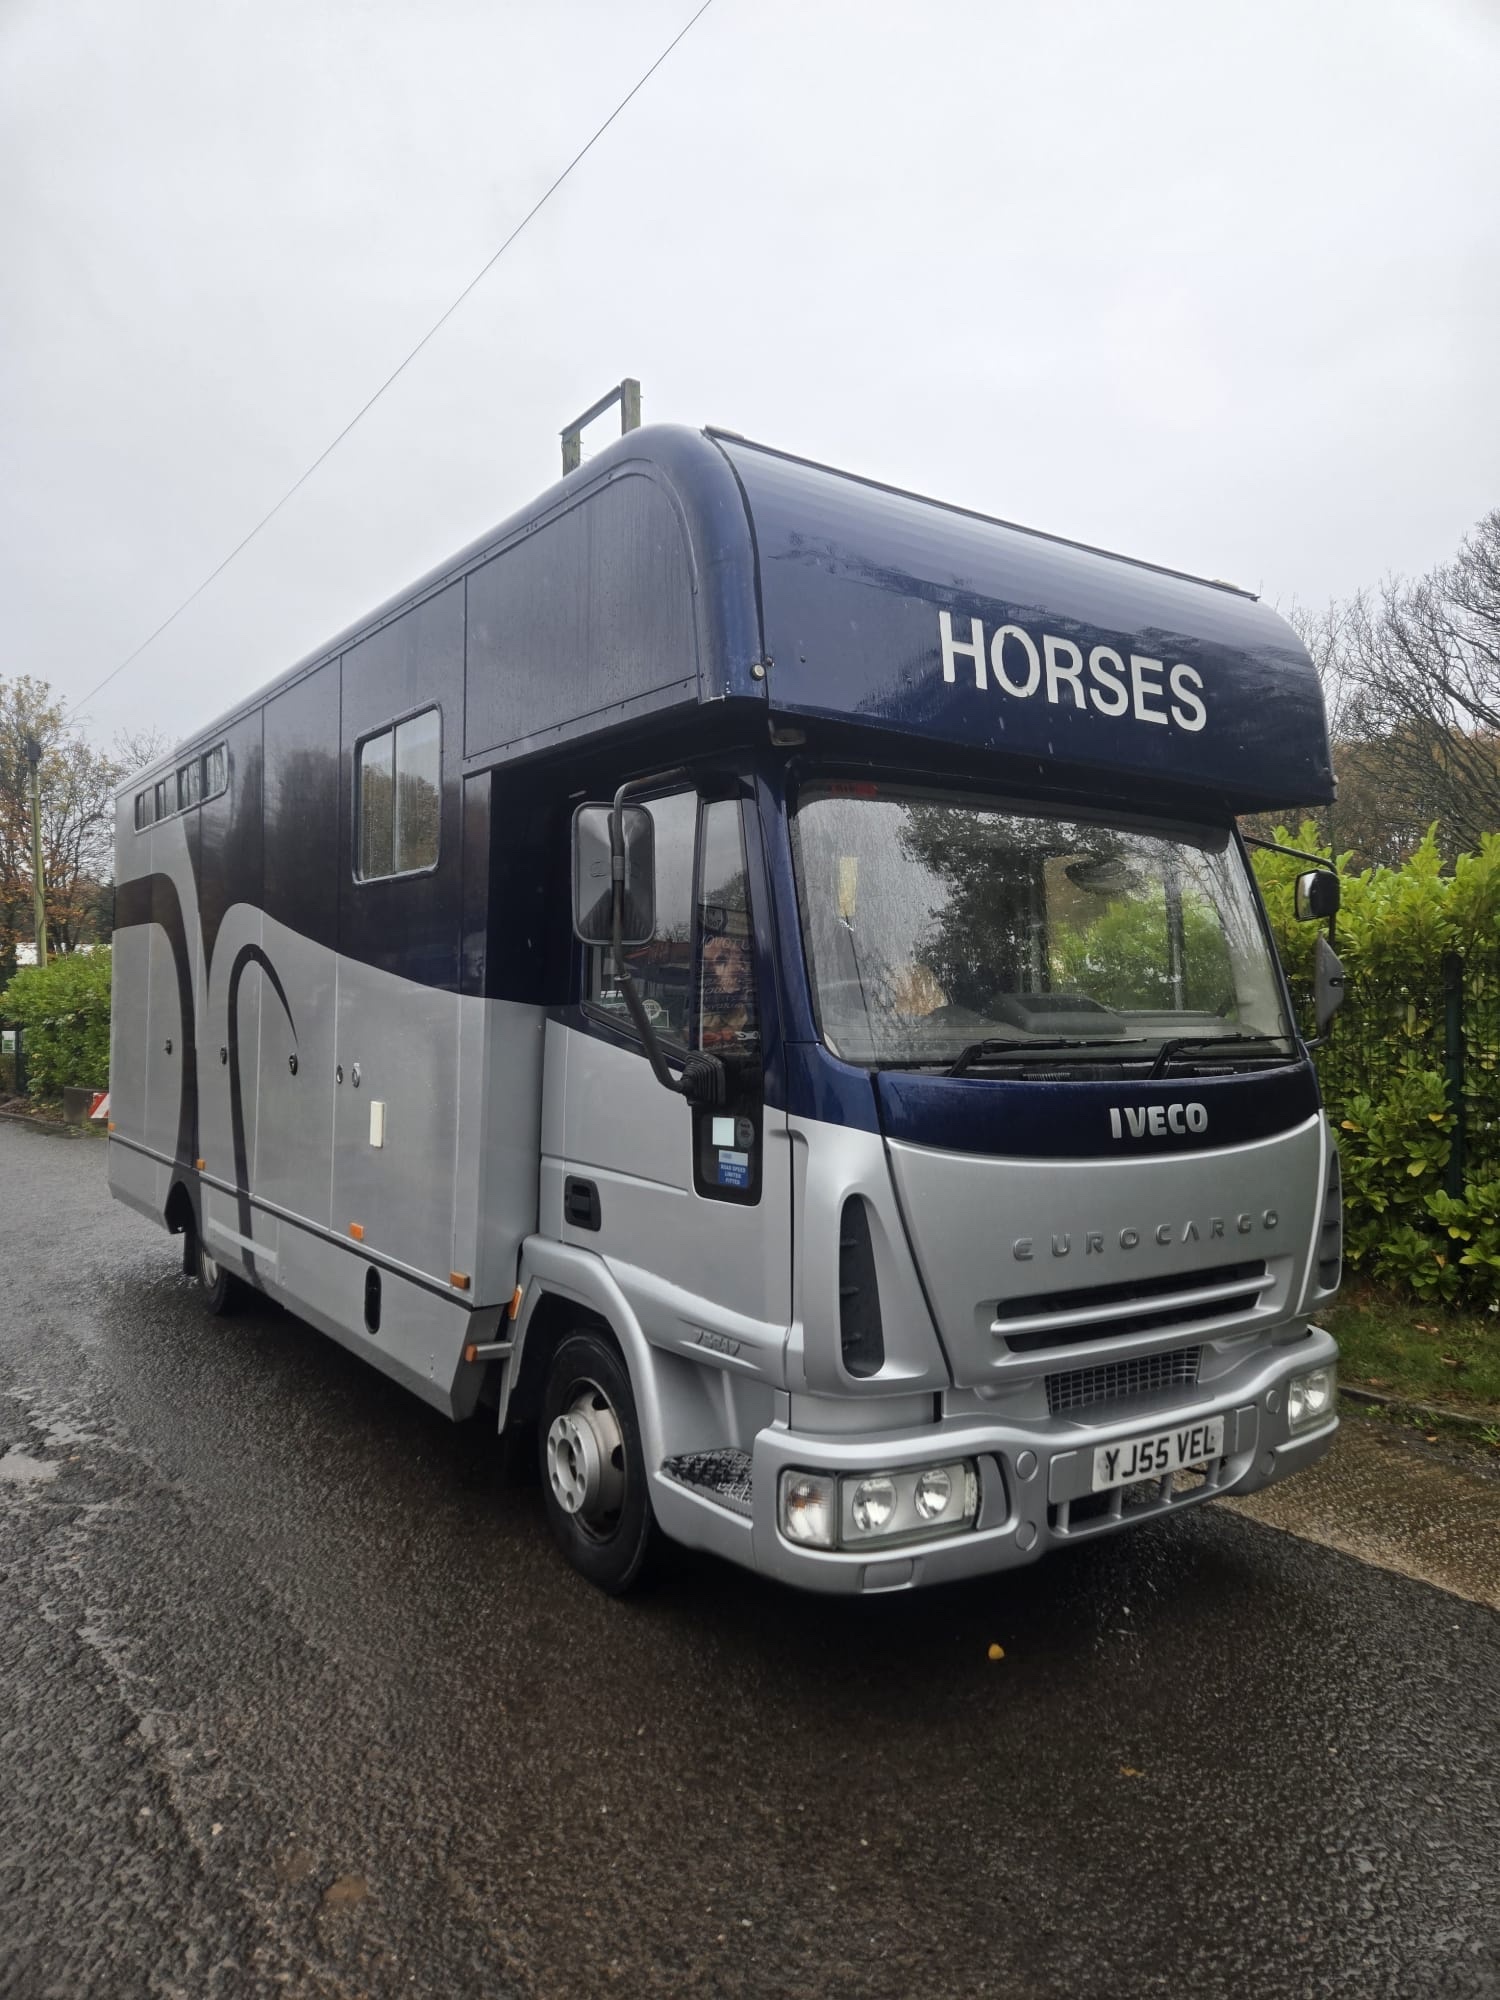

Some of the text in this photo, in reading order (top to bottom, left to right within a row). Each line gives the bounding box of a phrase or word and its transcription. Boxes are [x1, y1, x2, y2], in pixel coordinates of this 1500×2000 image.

[939, 610, 1207, 732] HORSES
[1109, 1102, 1208, 1139] IVECO
[1012, 1208, 1279, 1261] EUROCARGO
[1105, 1425, 1215, 1481] YJ55 VEL
